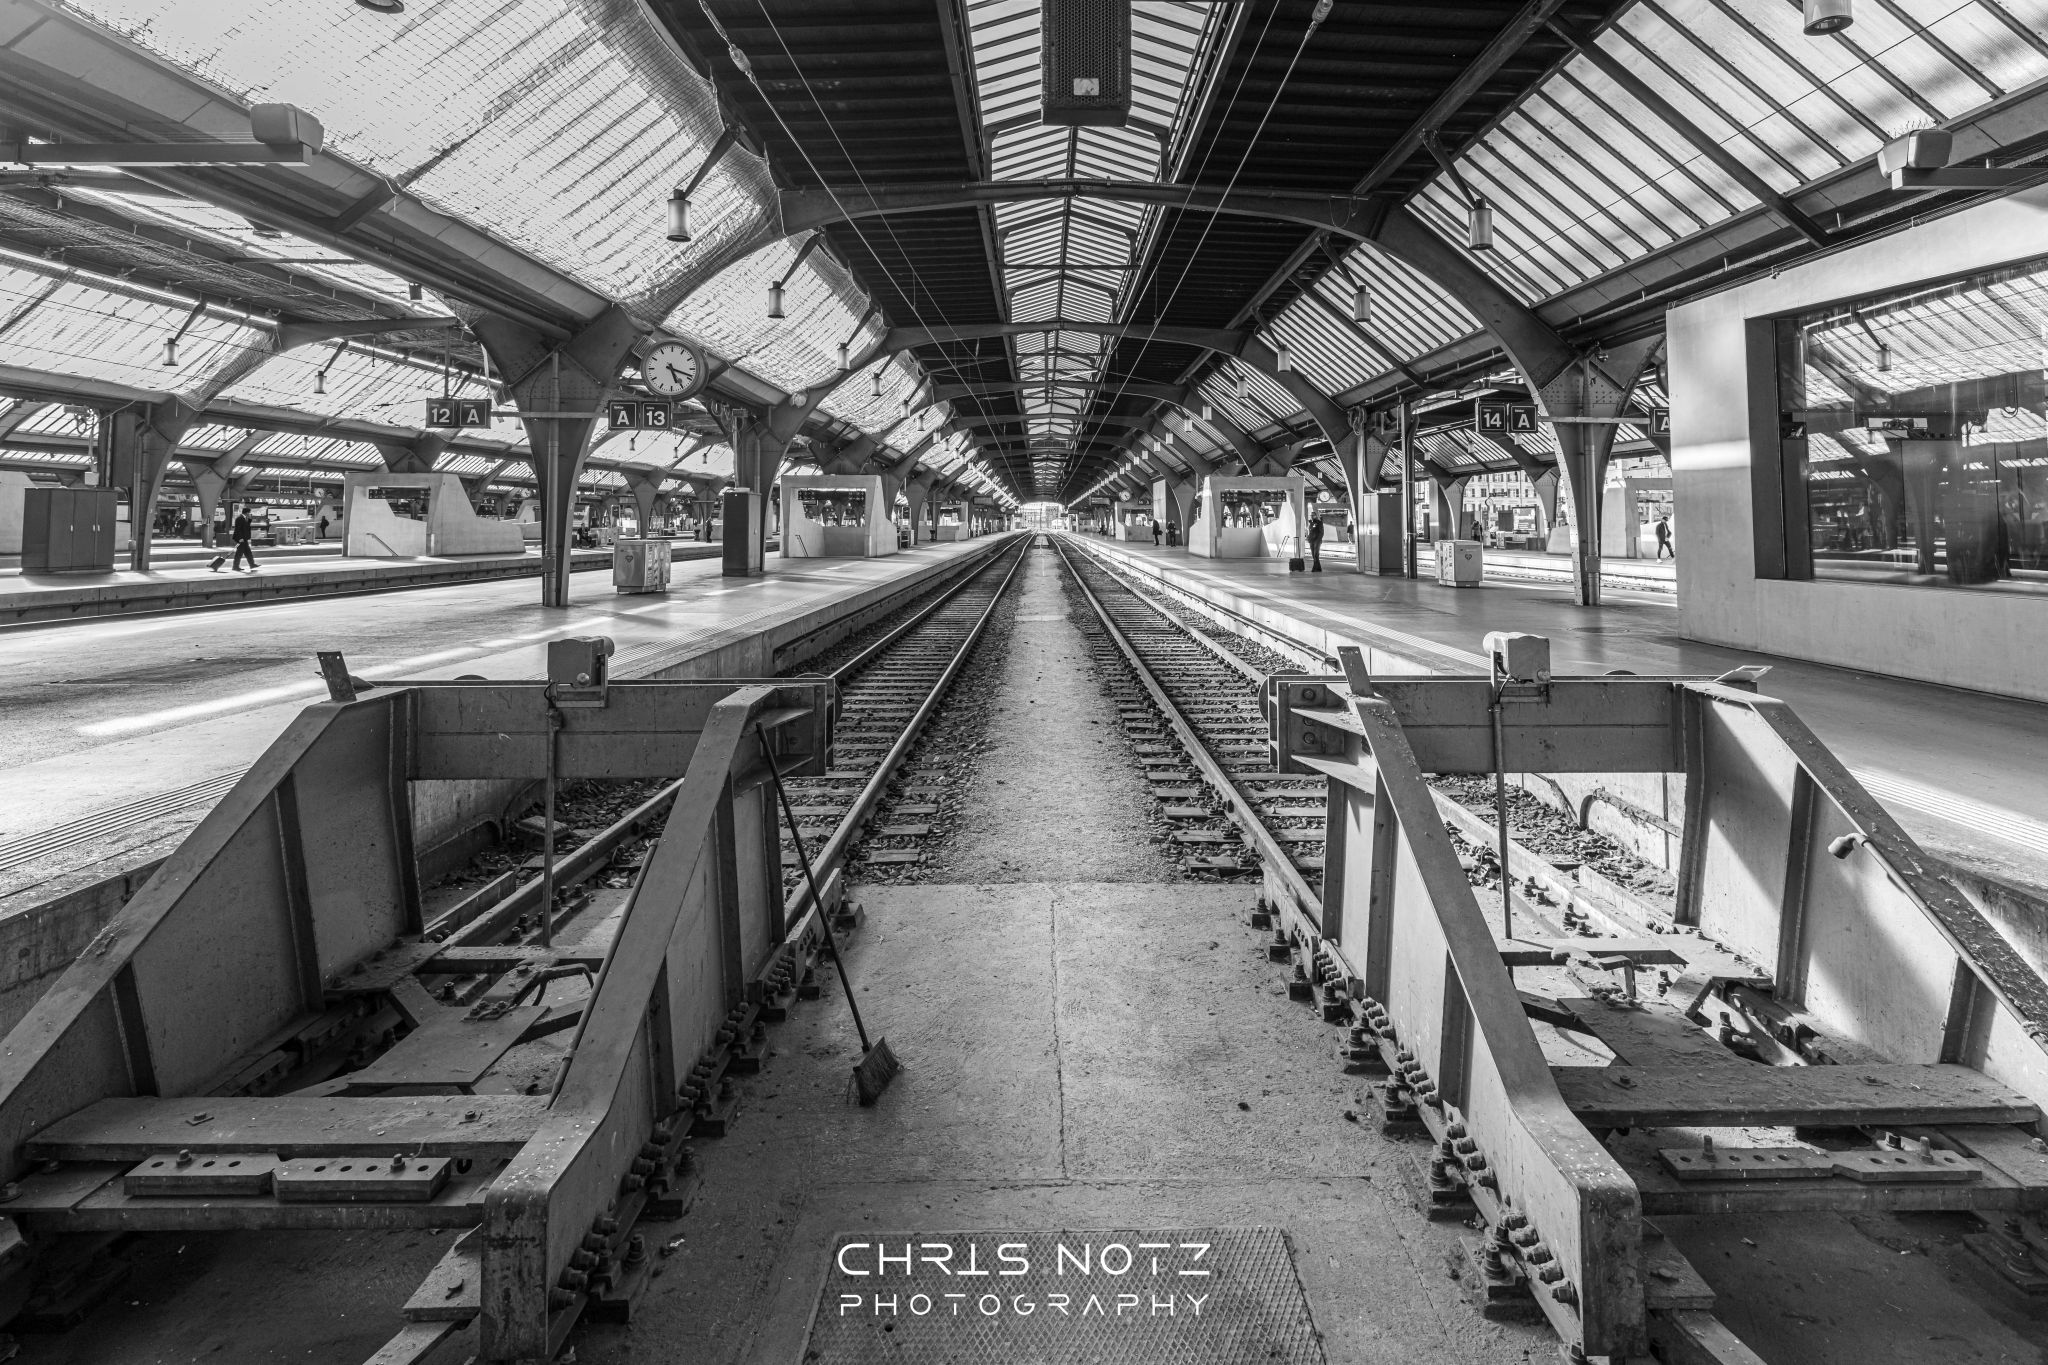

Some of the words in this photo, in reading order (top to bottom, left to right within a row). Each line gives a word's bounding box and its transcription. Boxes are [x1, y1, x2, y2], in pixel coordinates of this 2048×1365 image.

[431, 408, 450, 423] 12
[467, 408, 480, 424] A
[617, 410, 630, 425] A
[646, 410, 666, 426] 13
[1484, 412, 1502, 428] 14
[1517, 413, 1531, 428] A
[1660, 416, 1670, 431] A
